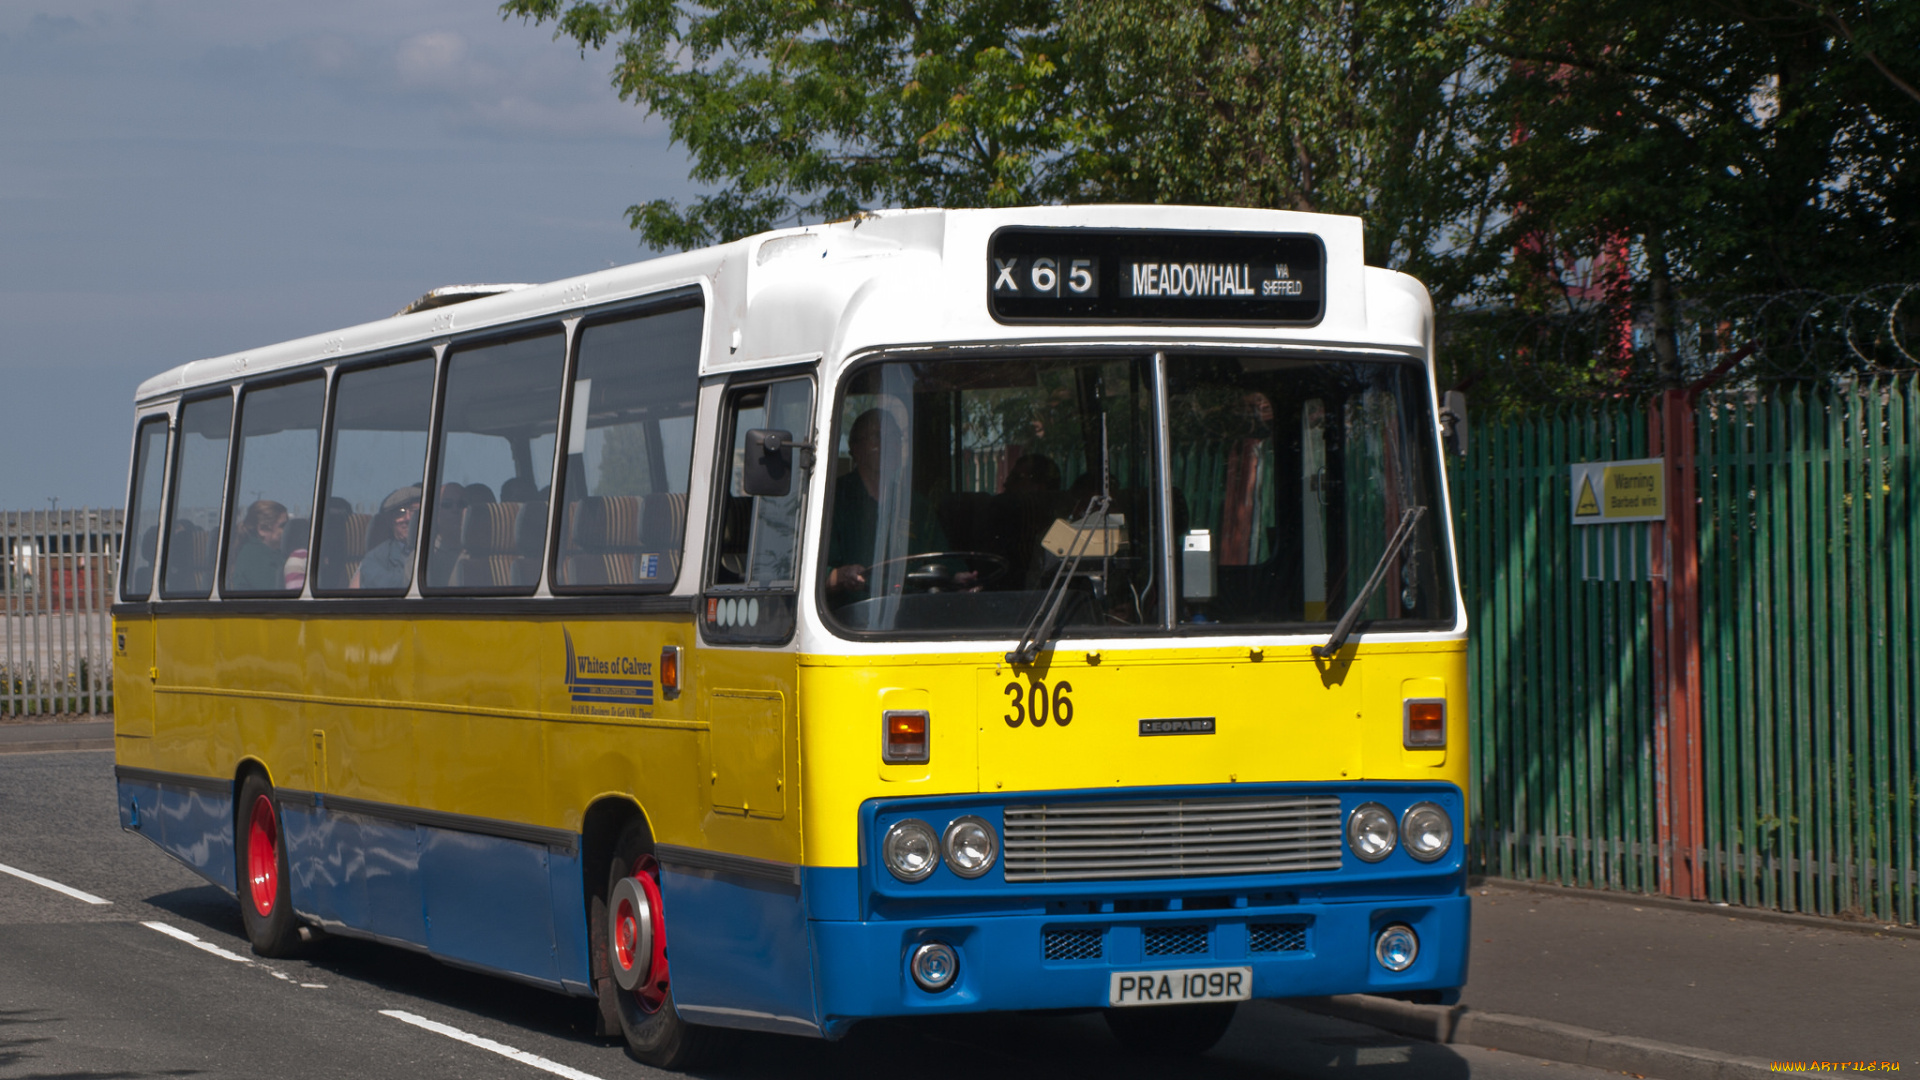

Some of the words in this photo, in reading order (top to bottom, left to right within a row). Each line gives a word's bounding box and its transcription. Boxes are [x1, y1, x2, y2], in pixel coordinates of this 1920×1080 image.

[1132, 263, 1255, 295] MEADOWHALL
[1275, 263, 1290, 279] VIA
[1262, 280, 1303, 296] SHEFFIELD
[1613, 473, 1654, 491] Warning
[1611, 496, 1639, 508] Barbed
[1641, 495, 1657, 507] wire
[577, 656, 609, 674] Whites
[611, 657, 620, 674] of
[621, 657, 652, 675] Calver
[1004, 681, 1074, 728] 306
[1141, 719, 1213, 733] LEOPARD
[1119, 975, 1173, 1001] PRA
[1182, 972, 1243, 998] 109R
